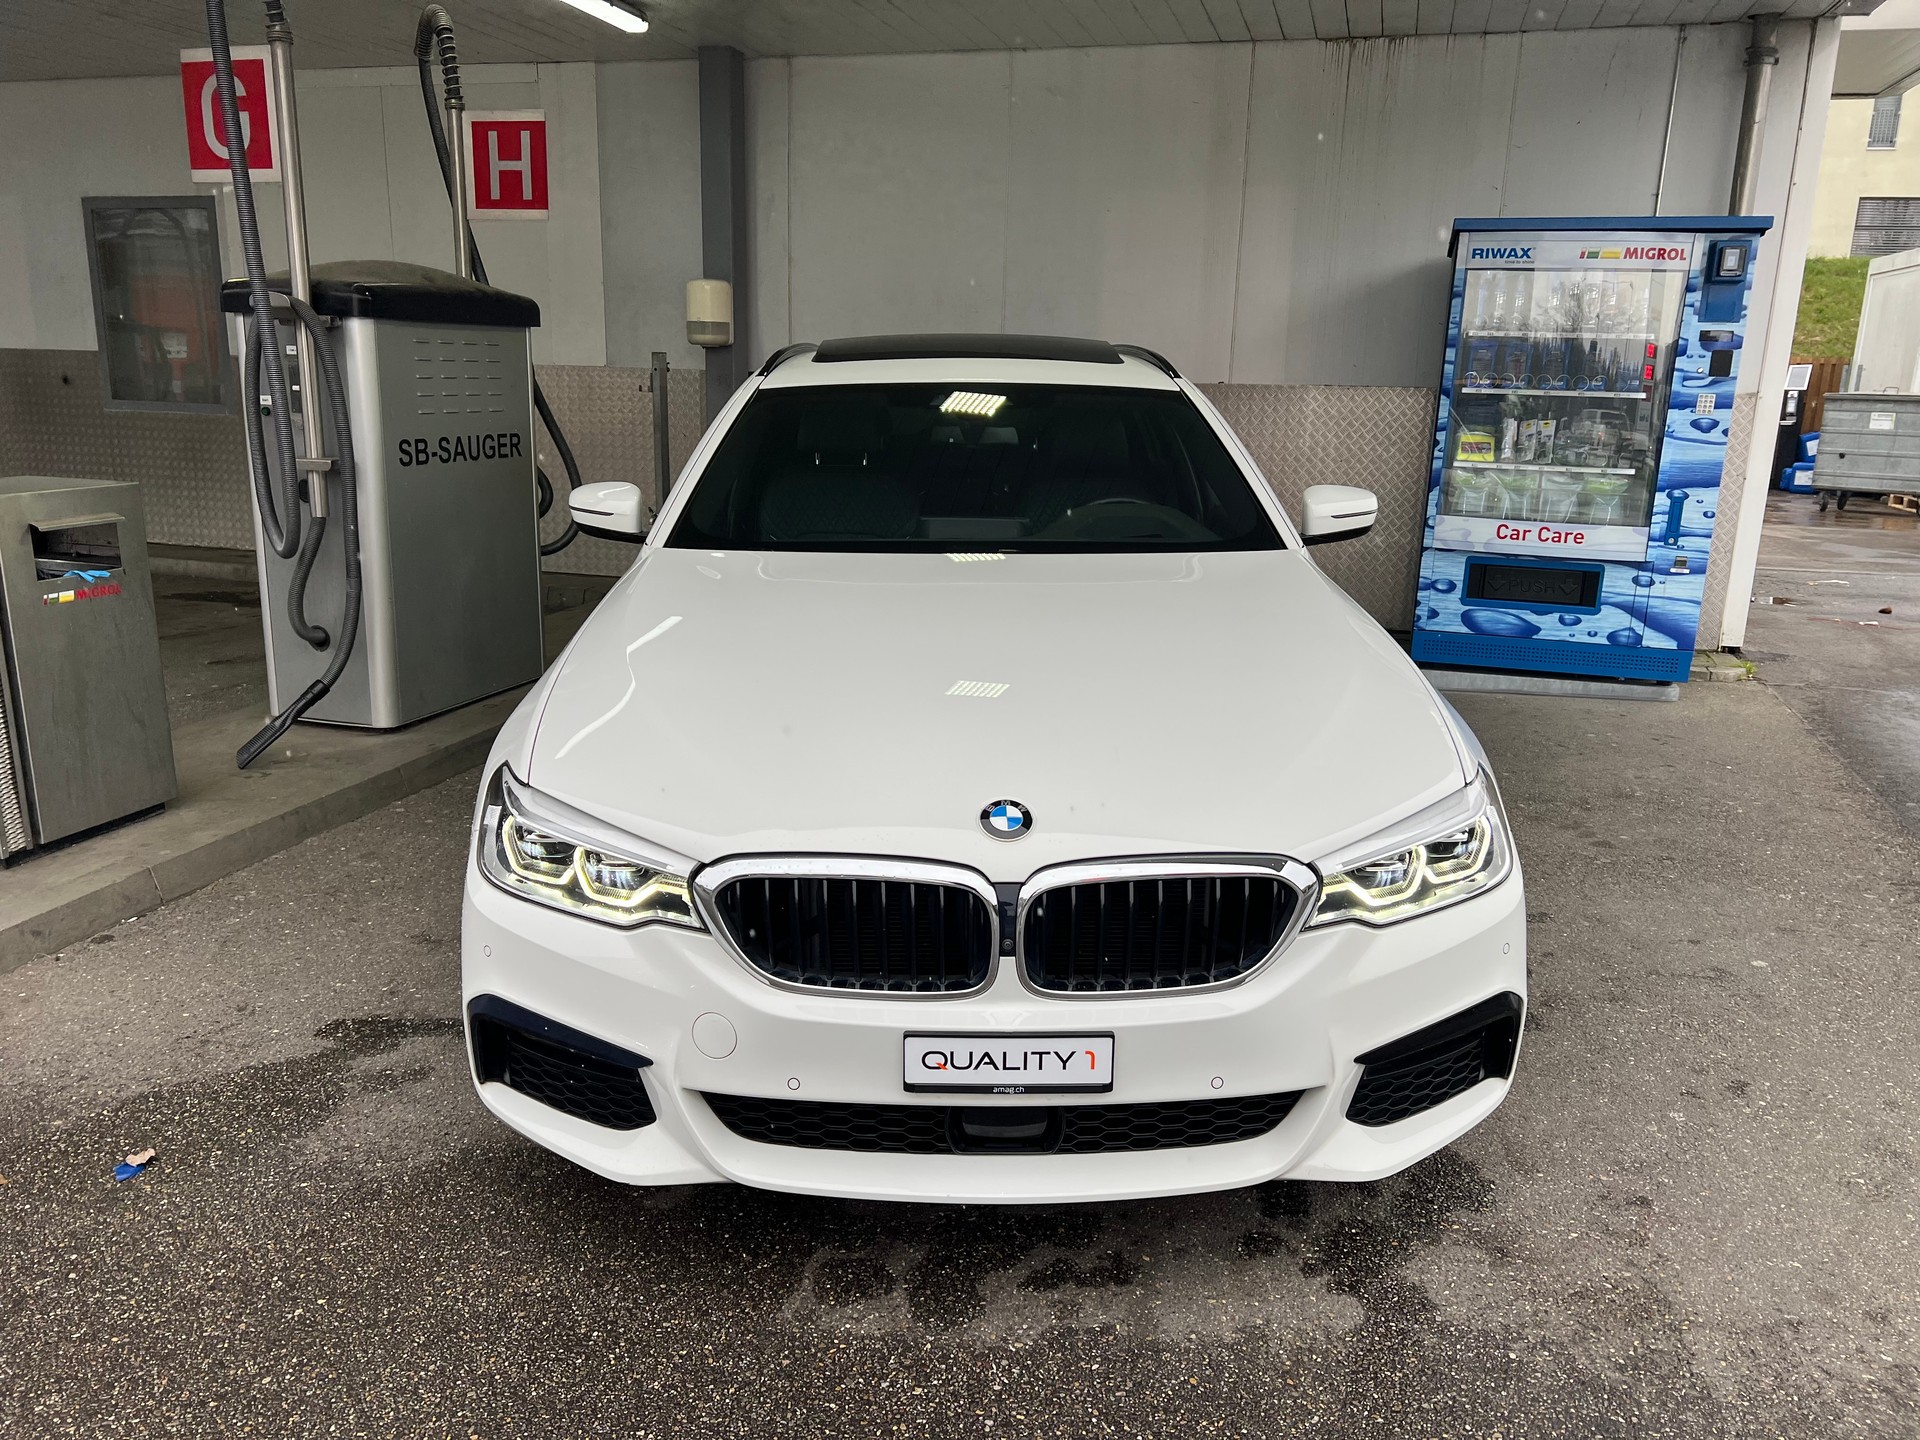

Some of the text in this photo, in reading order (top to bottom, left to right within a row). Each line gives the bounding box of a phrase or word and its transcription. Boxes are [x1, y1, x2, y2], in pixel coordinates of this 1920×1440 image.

[201, 73, 251, 160] G
[487, 130, 532, 200] H
[1471, 247, 1532, 259] RIWAX
[1623, 247, 1687, 261] MIGROL
[398, 433, 523, 467] SB-SAUGER
[1496, 523, 1585, 545] Car Care
[1508, 579, 1555, 593] PUSH
[985, 800, 1028, 812] BMW
[921, 1050, 1096, 1070] QUALITY 1
[992, 1086, 1025, 1095] amag.ch
